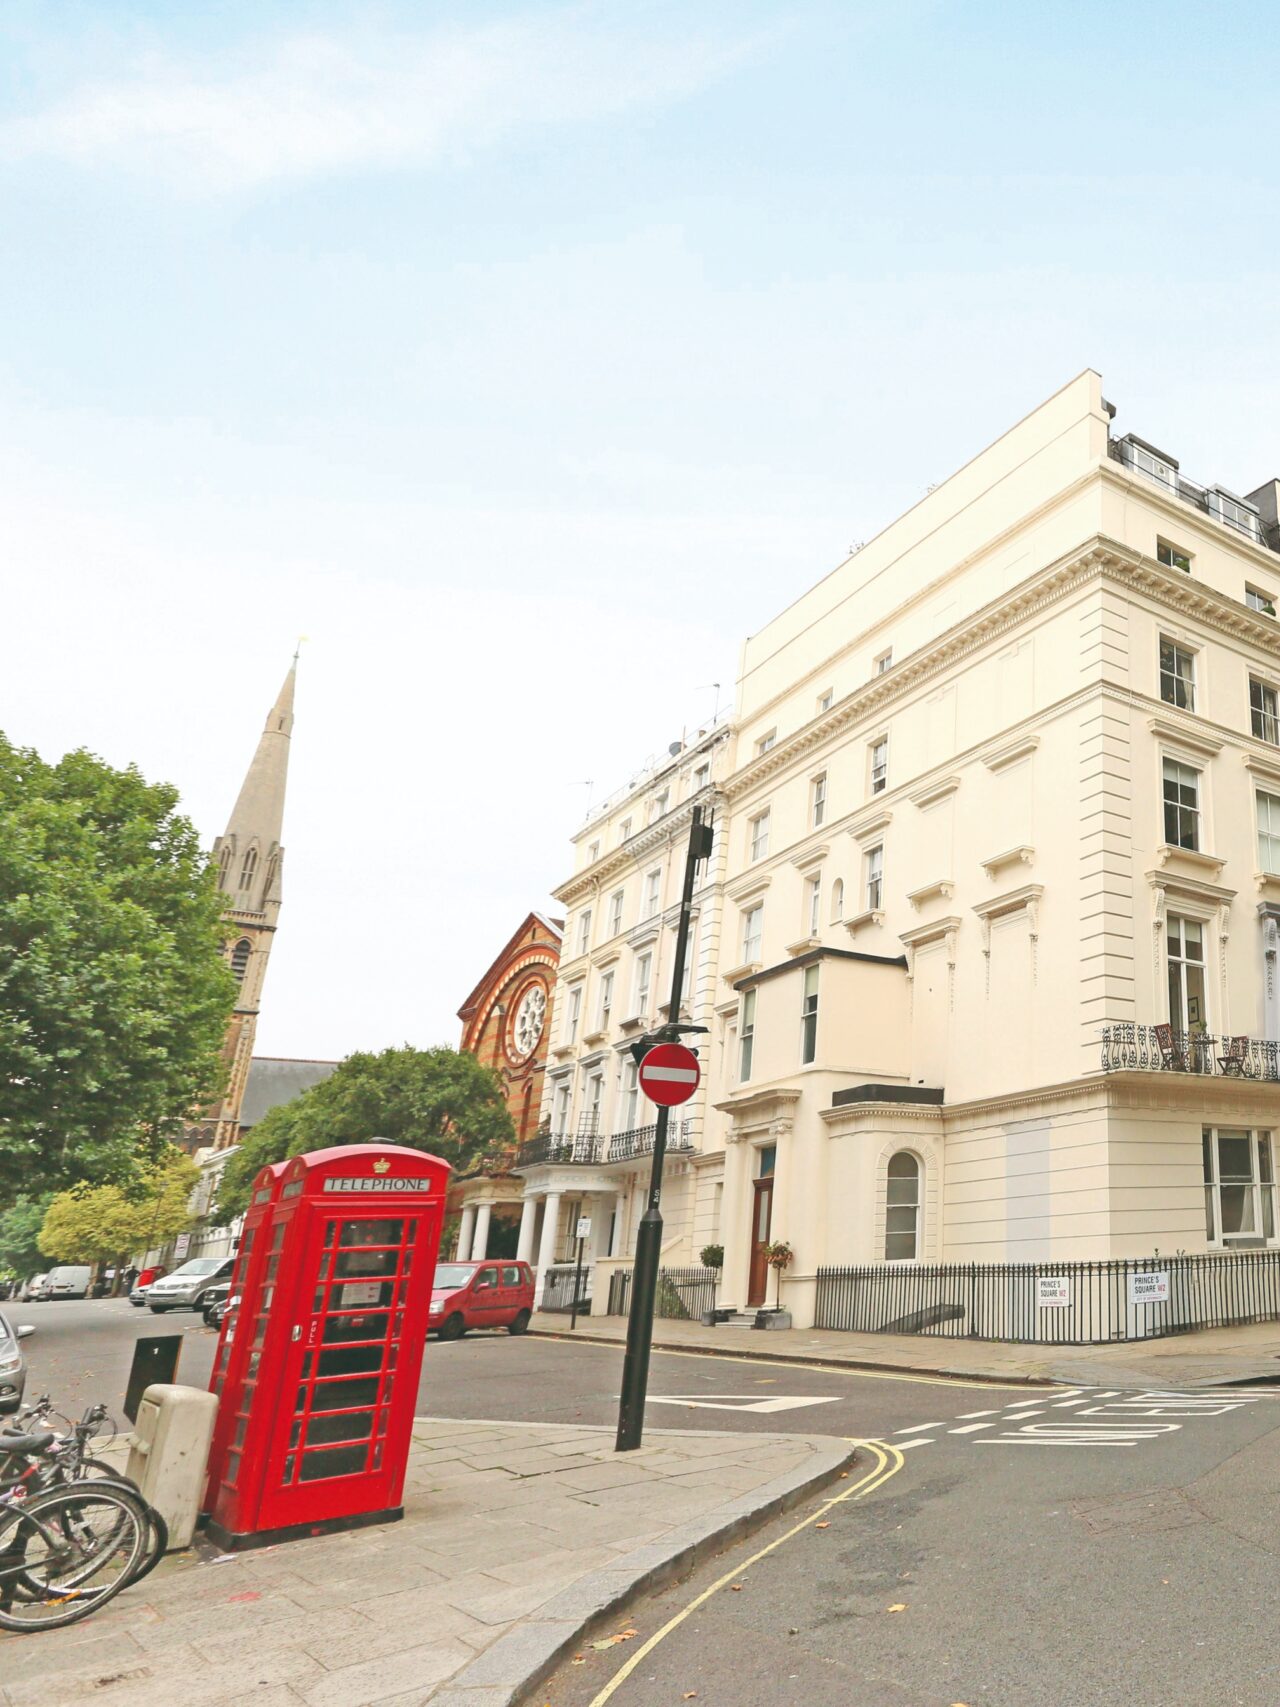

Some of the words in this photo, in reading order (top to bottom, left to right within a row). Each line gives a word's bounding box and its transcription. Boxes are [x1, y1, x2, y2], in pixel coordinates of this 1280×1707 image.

[330, 1178, 425, 1190] TELEPHONE
[1135, 1276, 1160, 1285] PRINCE'S
[1135, 1285, 1156, 1294] SQUARE
[971, 1423, 1183, 1446] NO
